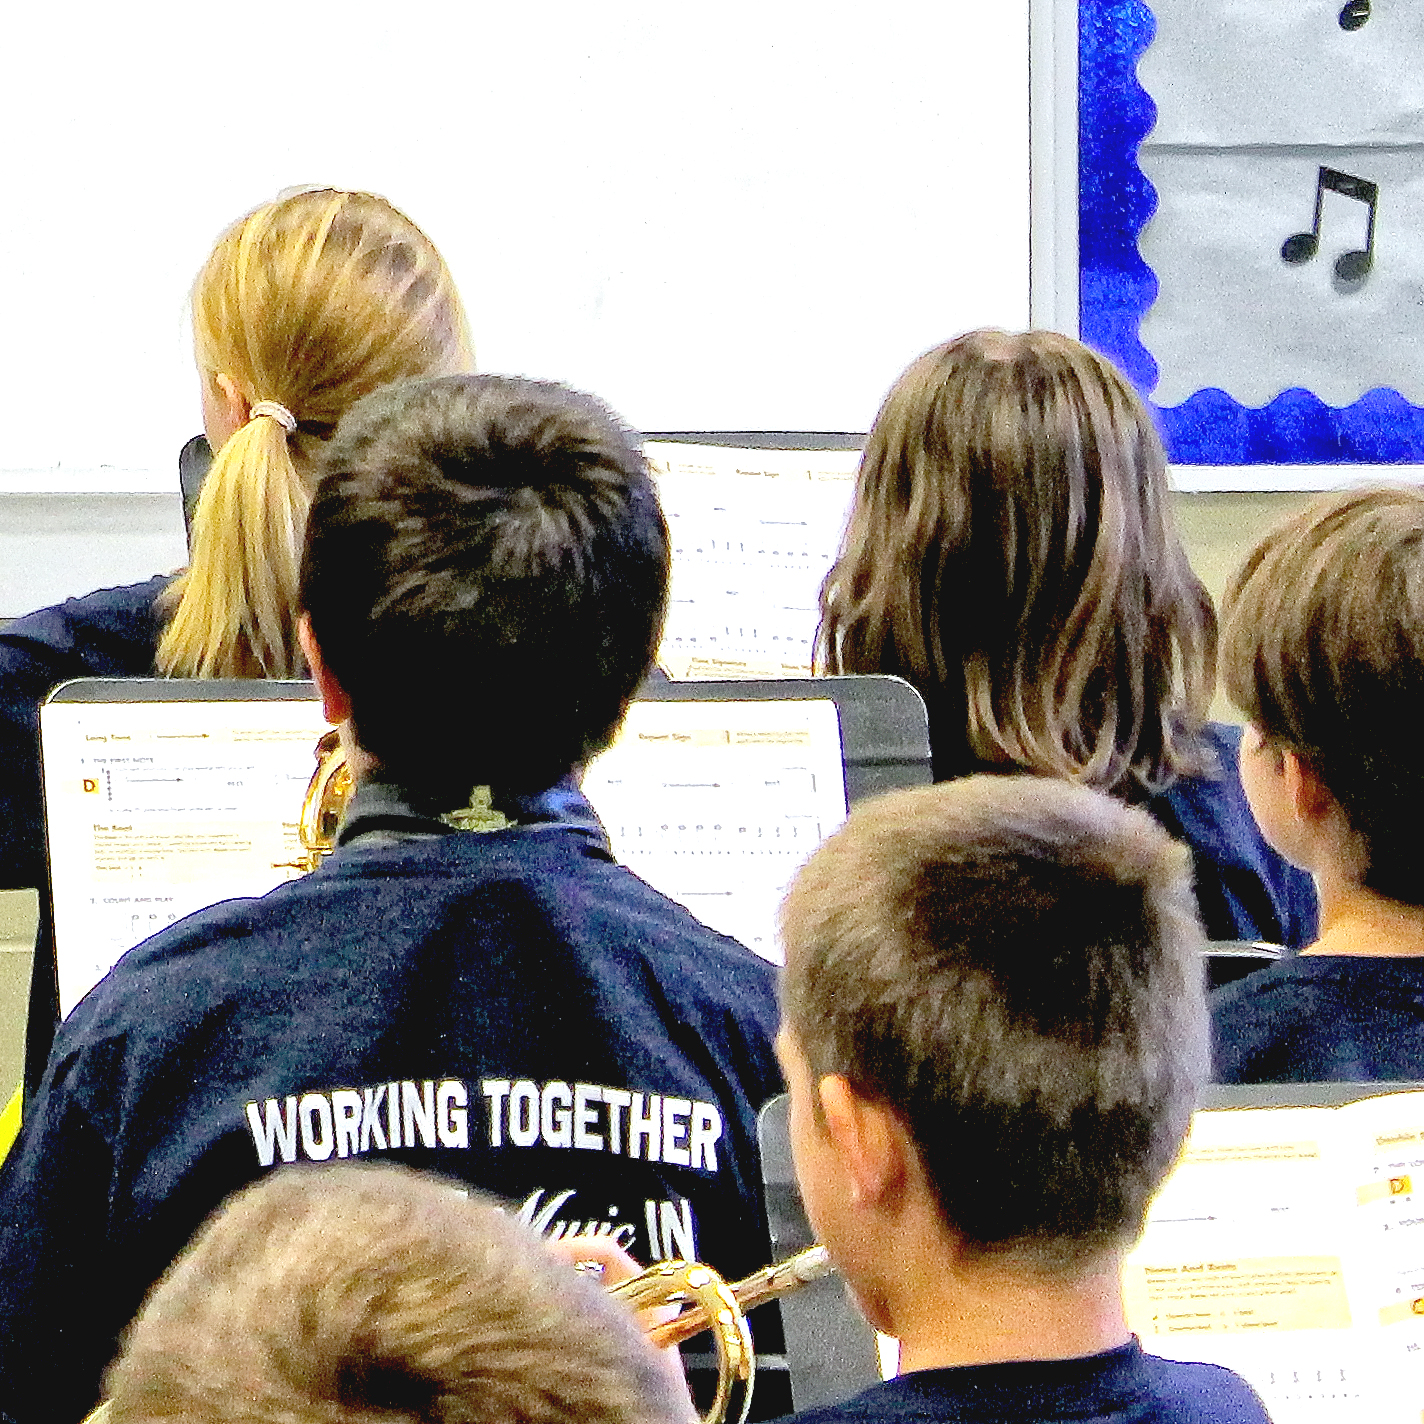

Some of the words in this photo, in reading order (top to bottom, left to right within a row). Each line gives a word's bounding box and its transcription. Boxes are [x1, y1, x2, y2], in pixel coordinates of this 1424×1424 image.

[83, 779, 96, 793] D
[246, 1080, 470, 1167] WORKING
[482, 1079, 724, 1172] TOGETHER
[644, 1197, 697, 1263] IN
